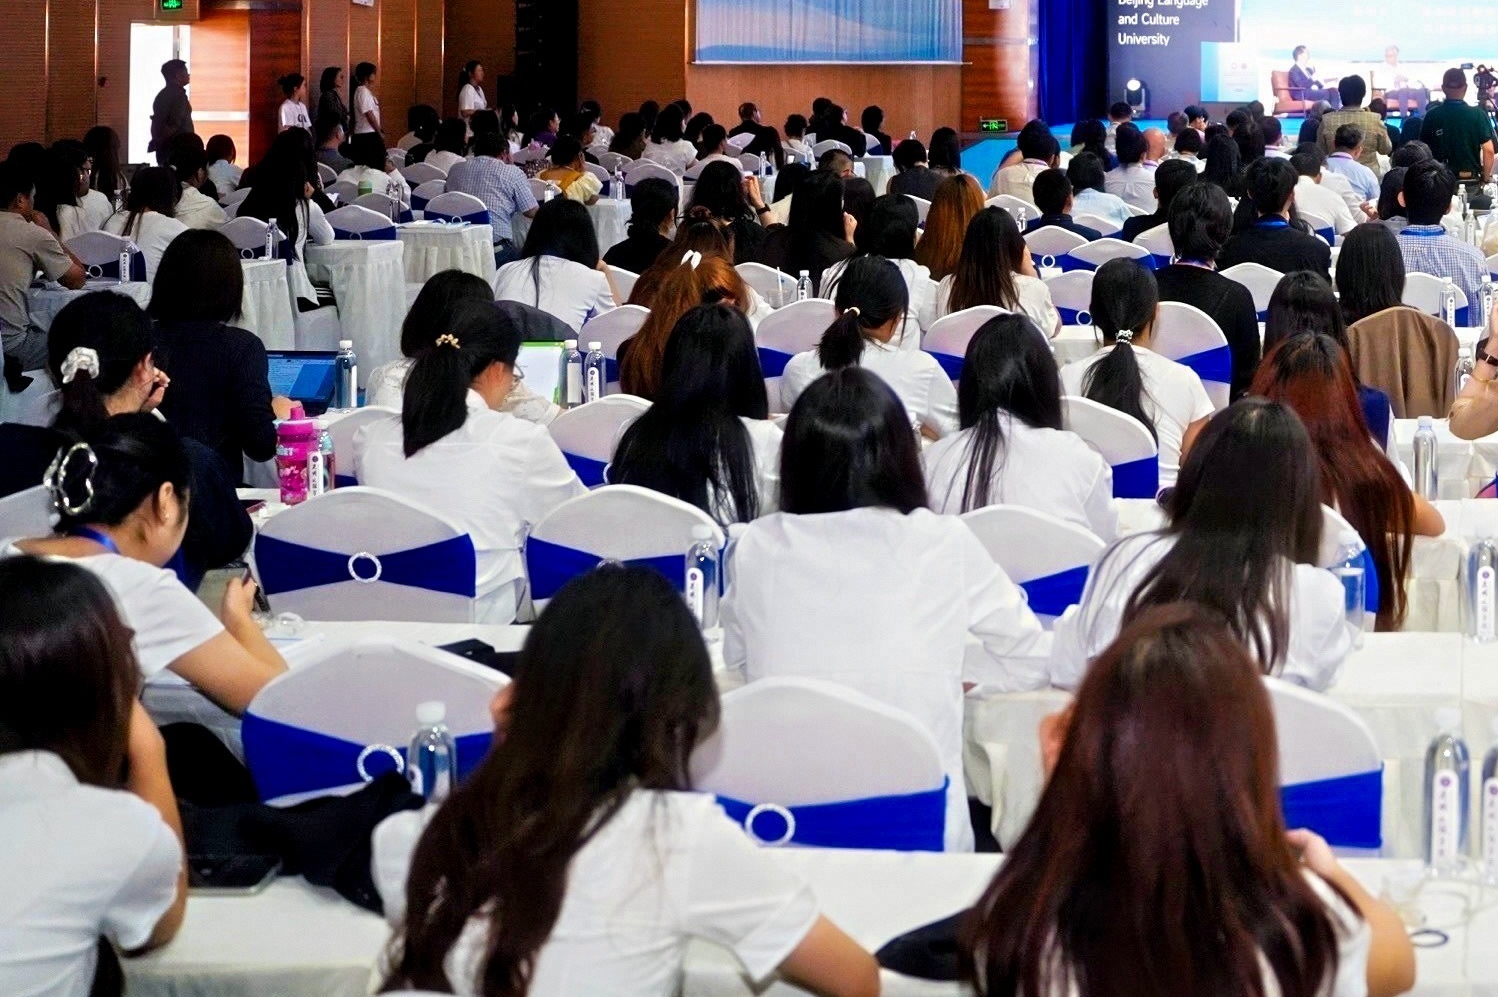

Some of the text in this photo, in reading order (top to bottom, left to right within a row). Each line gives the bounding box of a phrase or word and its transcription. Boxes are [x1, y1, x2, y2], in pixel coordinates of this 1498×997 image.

[1117, 12, 1180, 25] and Culture
[1117, 32, 1170, 46] University
